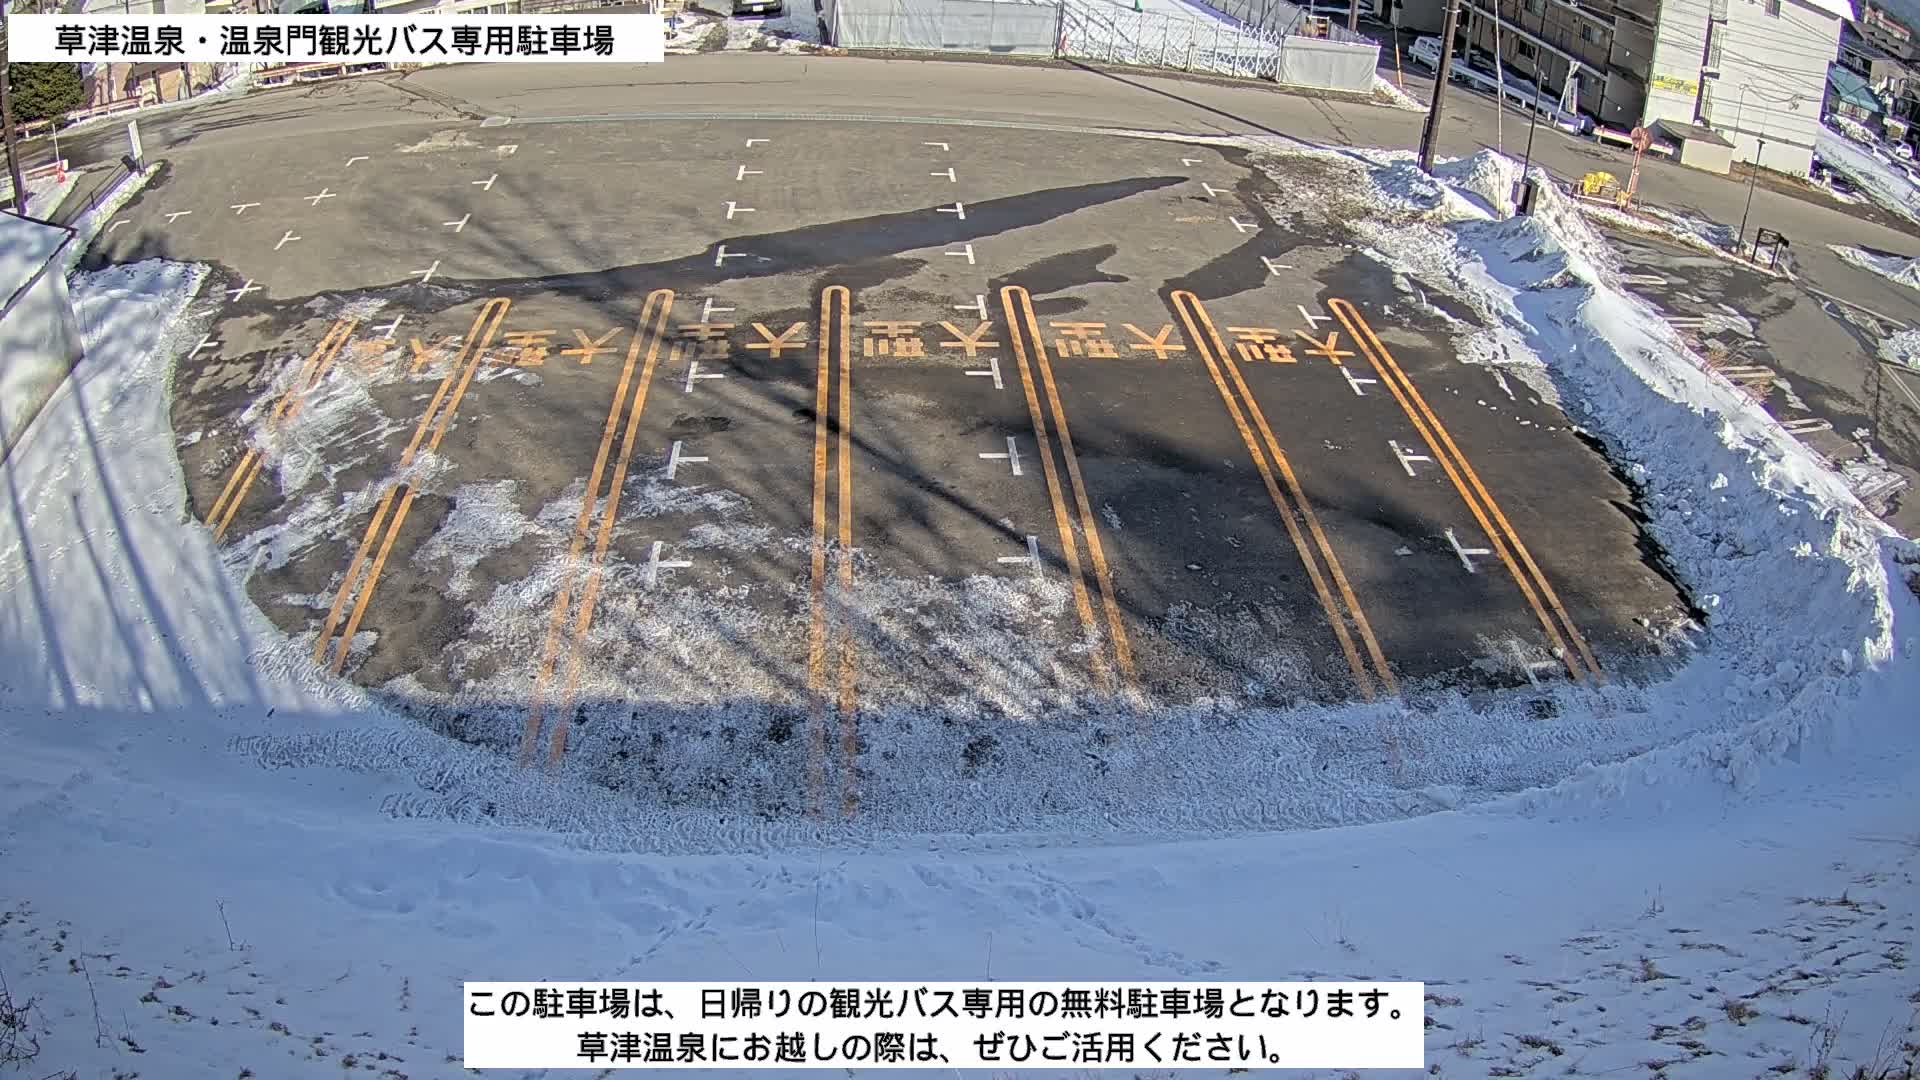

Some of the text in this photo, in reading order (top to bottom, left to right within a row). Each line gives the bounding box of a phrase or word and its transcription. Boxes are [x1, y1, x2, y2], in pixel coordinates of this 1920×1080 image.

[669, 322, 808, 361] 大型
[863, 320, 1000, 358] 大型
[1049, 321, 1187, 360] 大型
[1226, 325, 1356, 365] 大型
